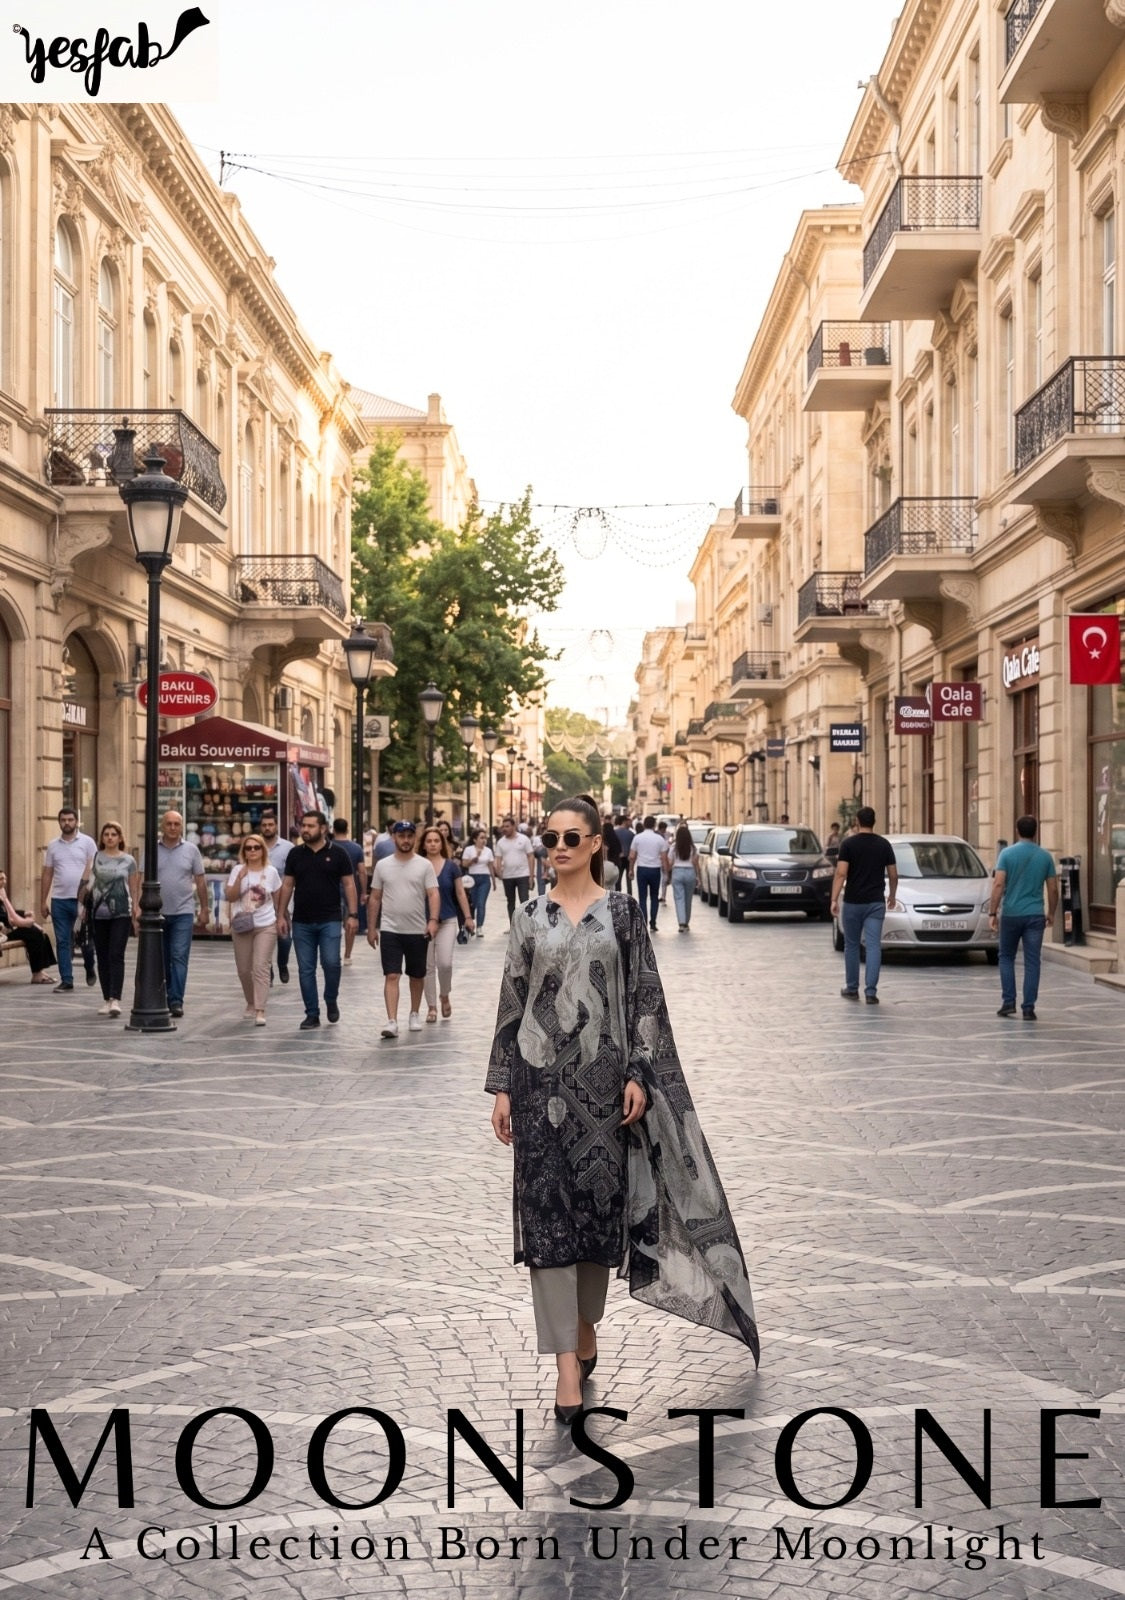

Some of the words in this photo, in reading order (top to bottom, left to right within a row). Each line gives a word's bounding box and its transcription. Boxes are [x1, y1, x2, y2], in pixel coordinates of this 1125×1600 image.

[161, 680, 195, 691] BAKU
[941, 703, 973, 717] Cafe
[160, 743, 196, 757] Baku
[200, 743, 271, 757] Souvenirs
